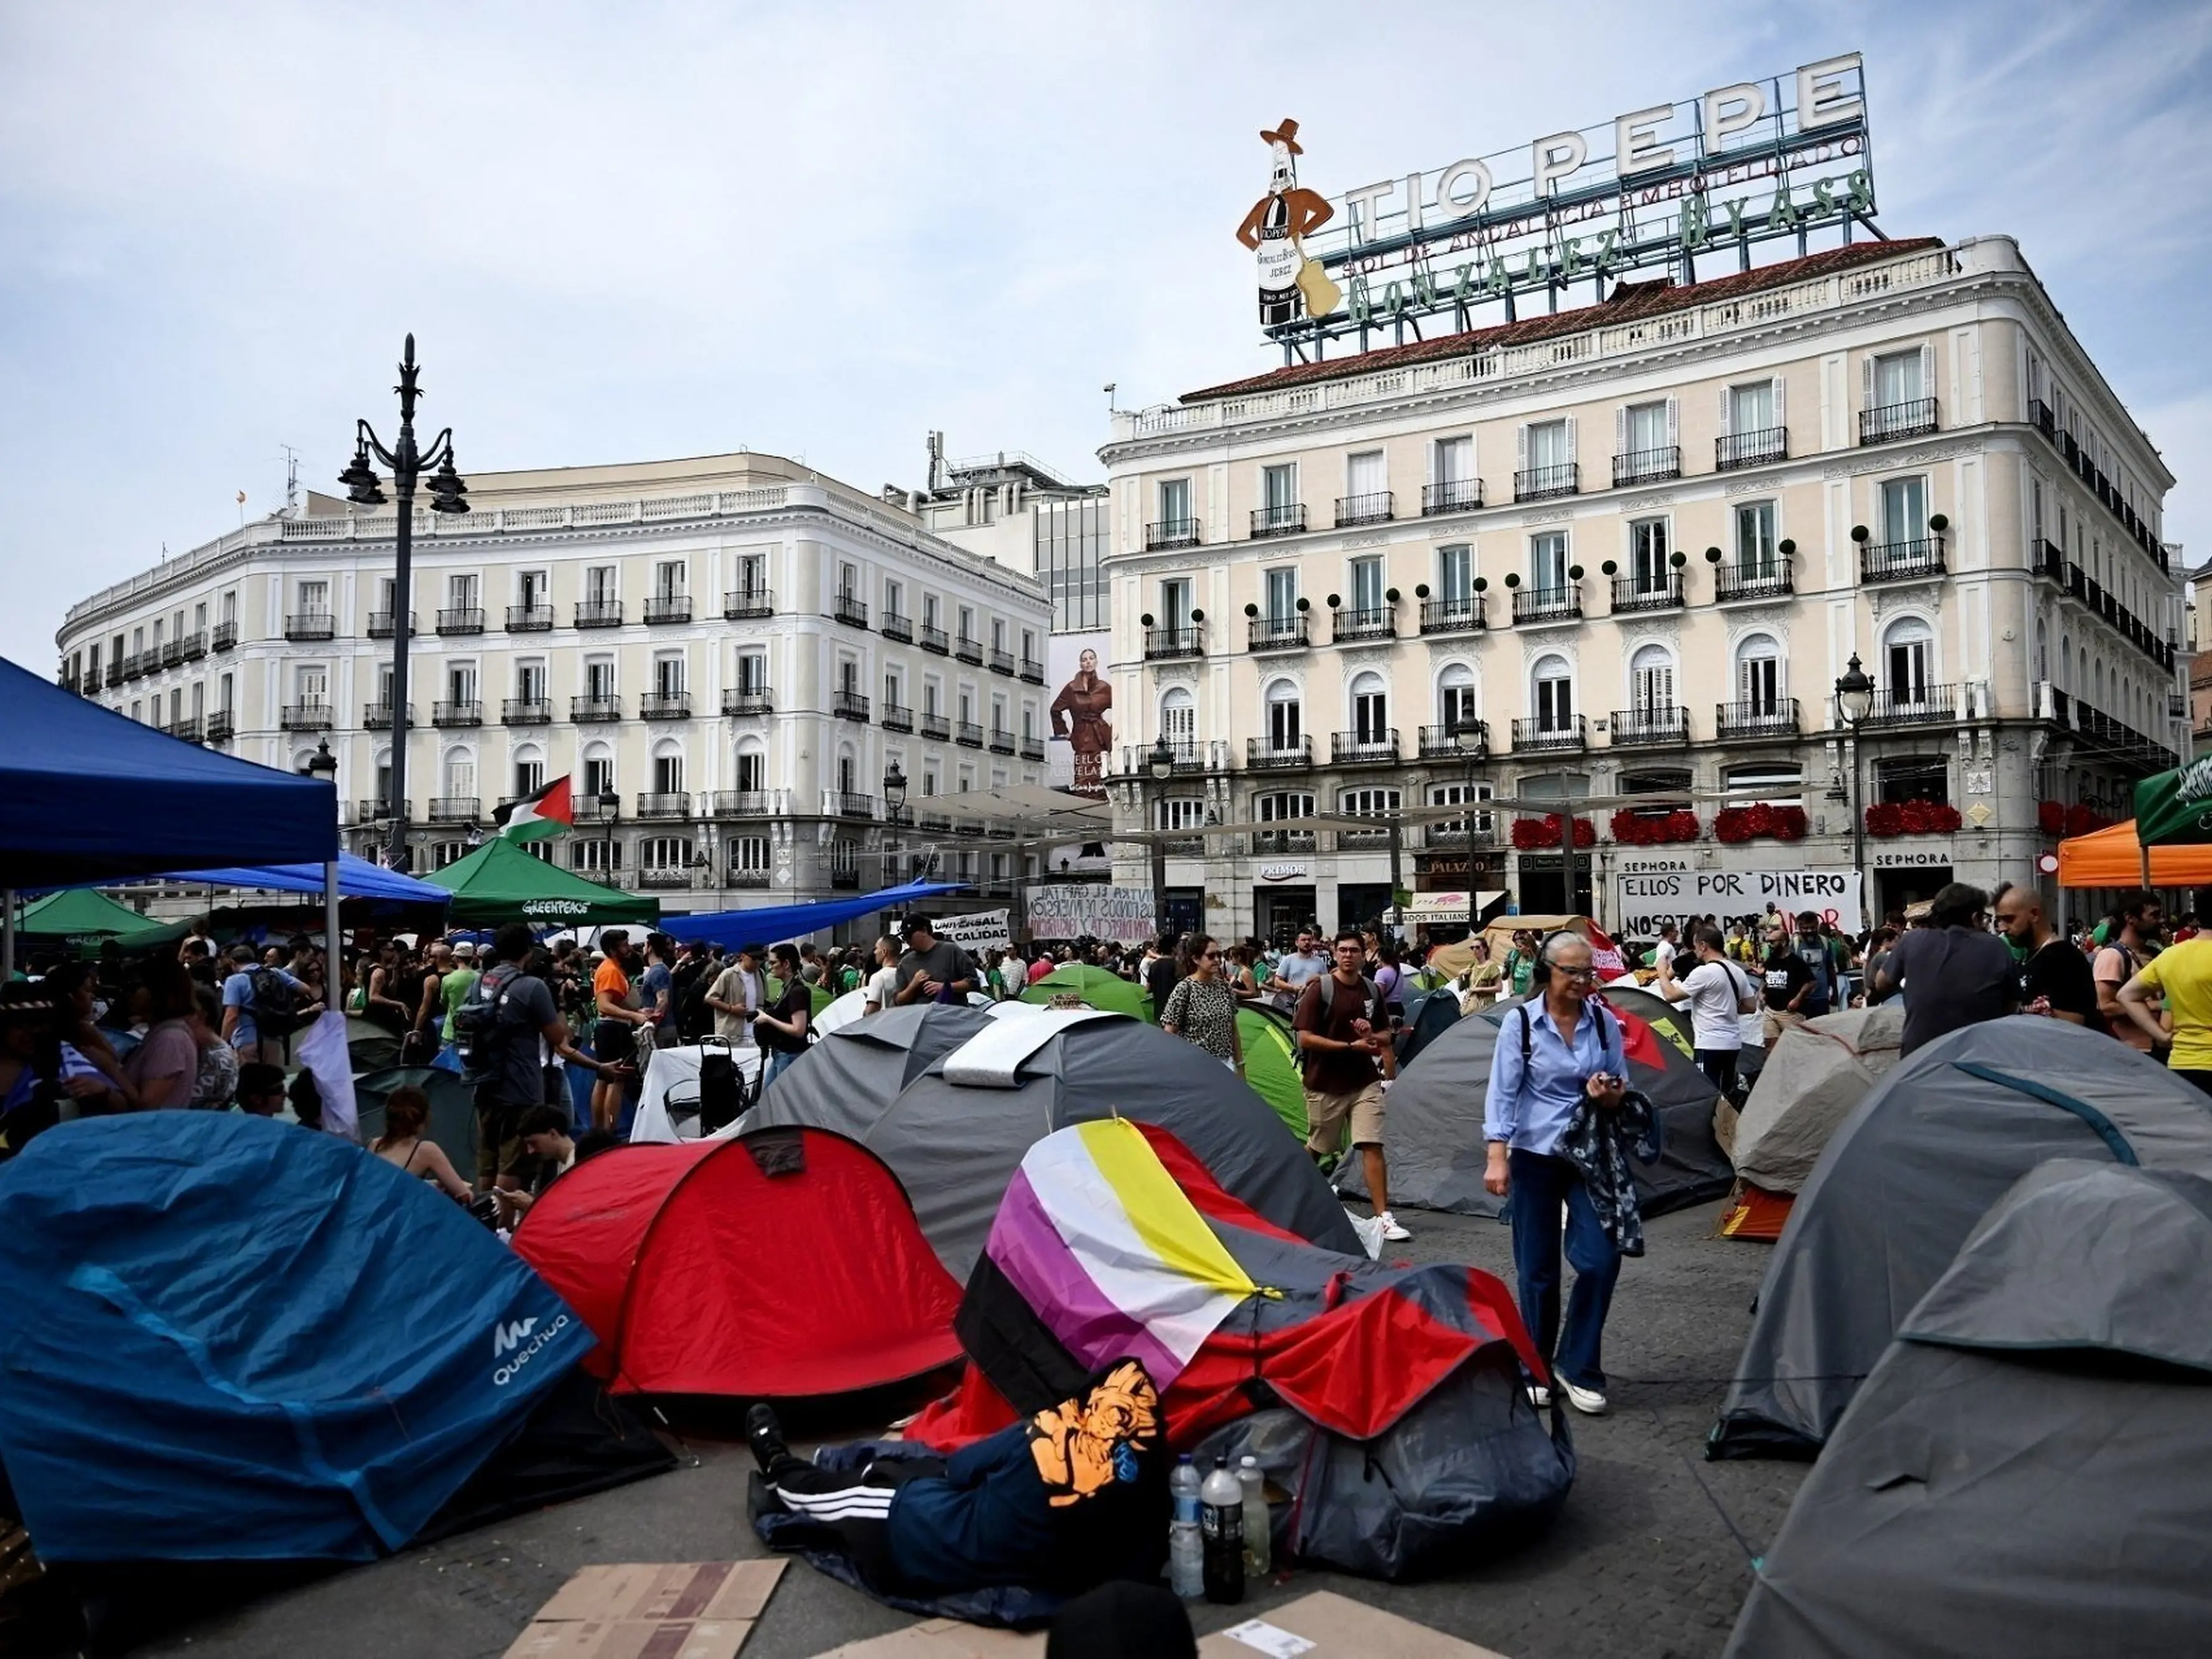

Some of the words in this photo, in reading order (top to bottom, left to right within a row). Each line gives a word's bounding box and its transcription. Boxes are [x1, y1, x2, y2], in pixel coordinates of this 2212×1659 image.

[1346, 158, 1492, 242] TIO
[1534, 52, 1864, 199] PEPE
[1348, 227, 1620, 324] GONZALEZ
[1680, 168, 1869, 249] BYASS
[1342, 255, 1393, 278] SOL
[1432, 861, 1485, 872] PALAZO
[1624, 861, 1687, 872] SEPHORA
[1876, 853, 1949, 866] SEPHORA
[1625, 875, 1681, 897] ELLOS
[1698, 874, 1744, 897] POR
[1386, 914, 1427, 922] HADOS
[1430, 912, 1470, 922] ITALIANO
[955, 929, 1008, 942] CALIDAD
[493, 1314, 569, 1385] Quechua
